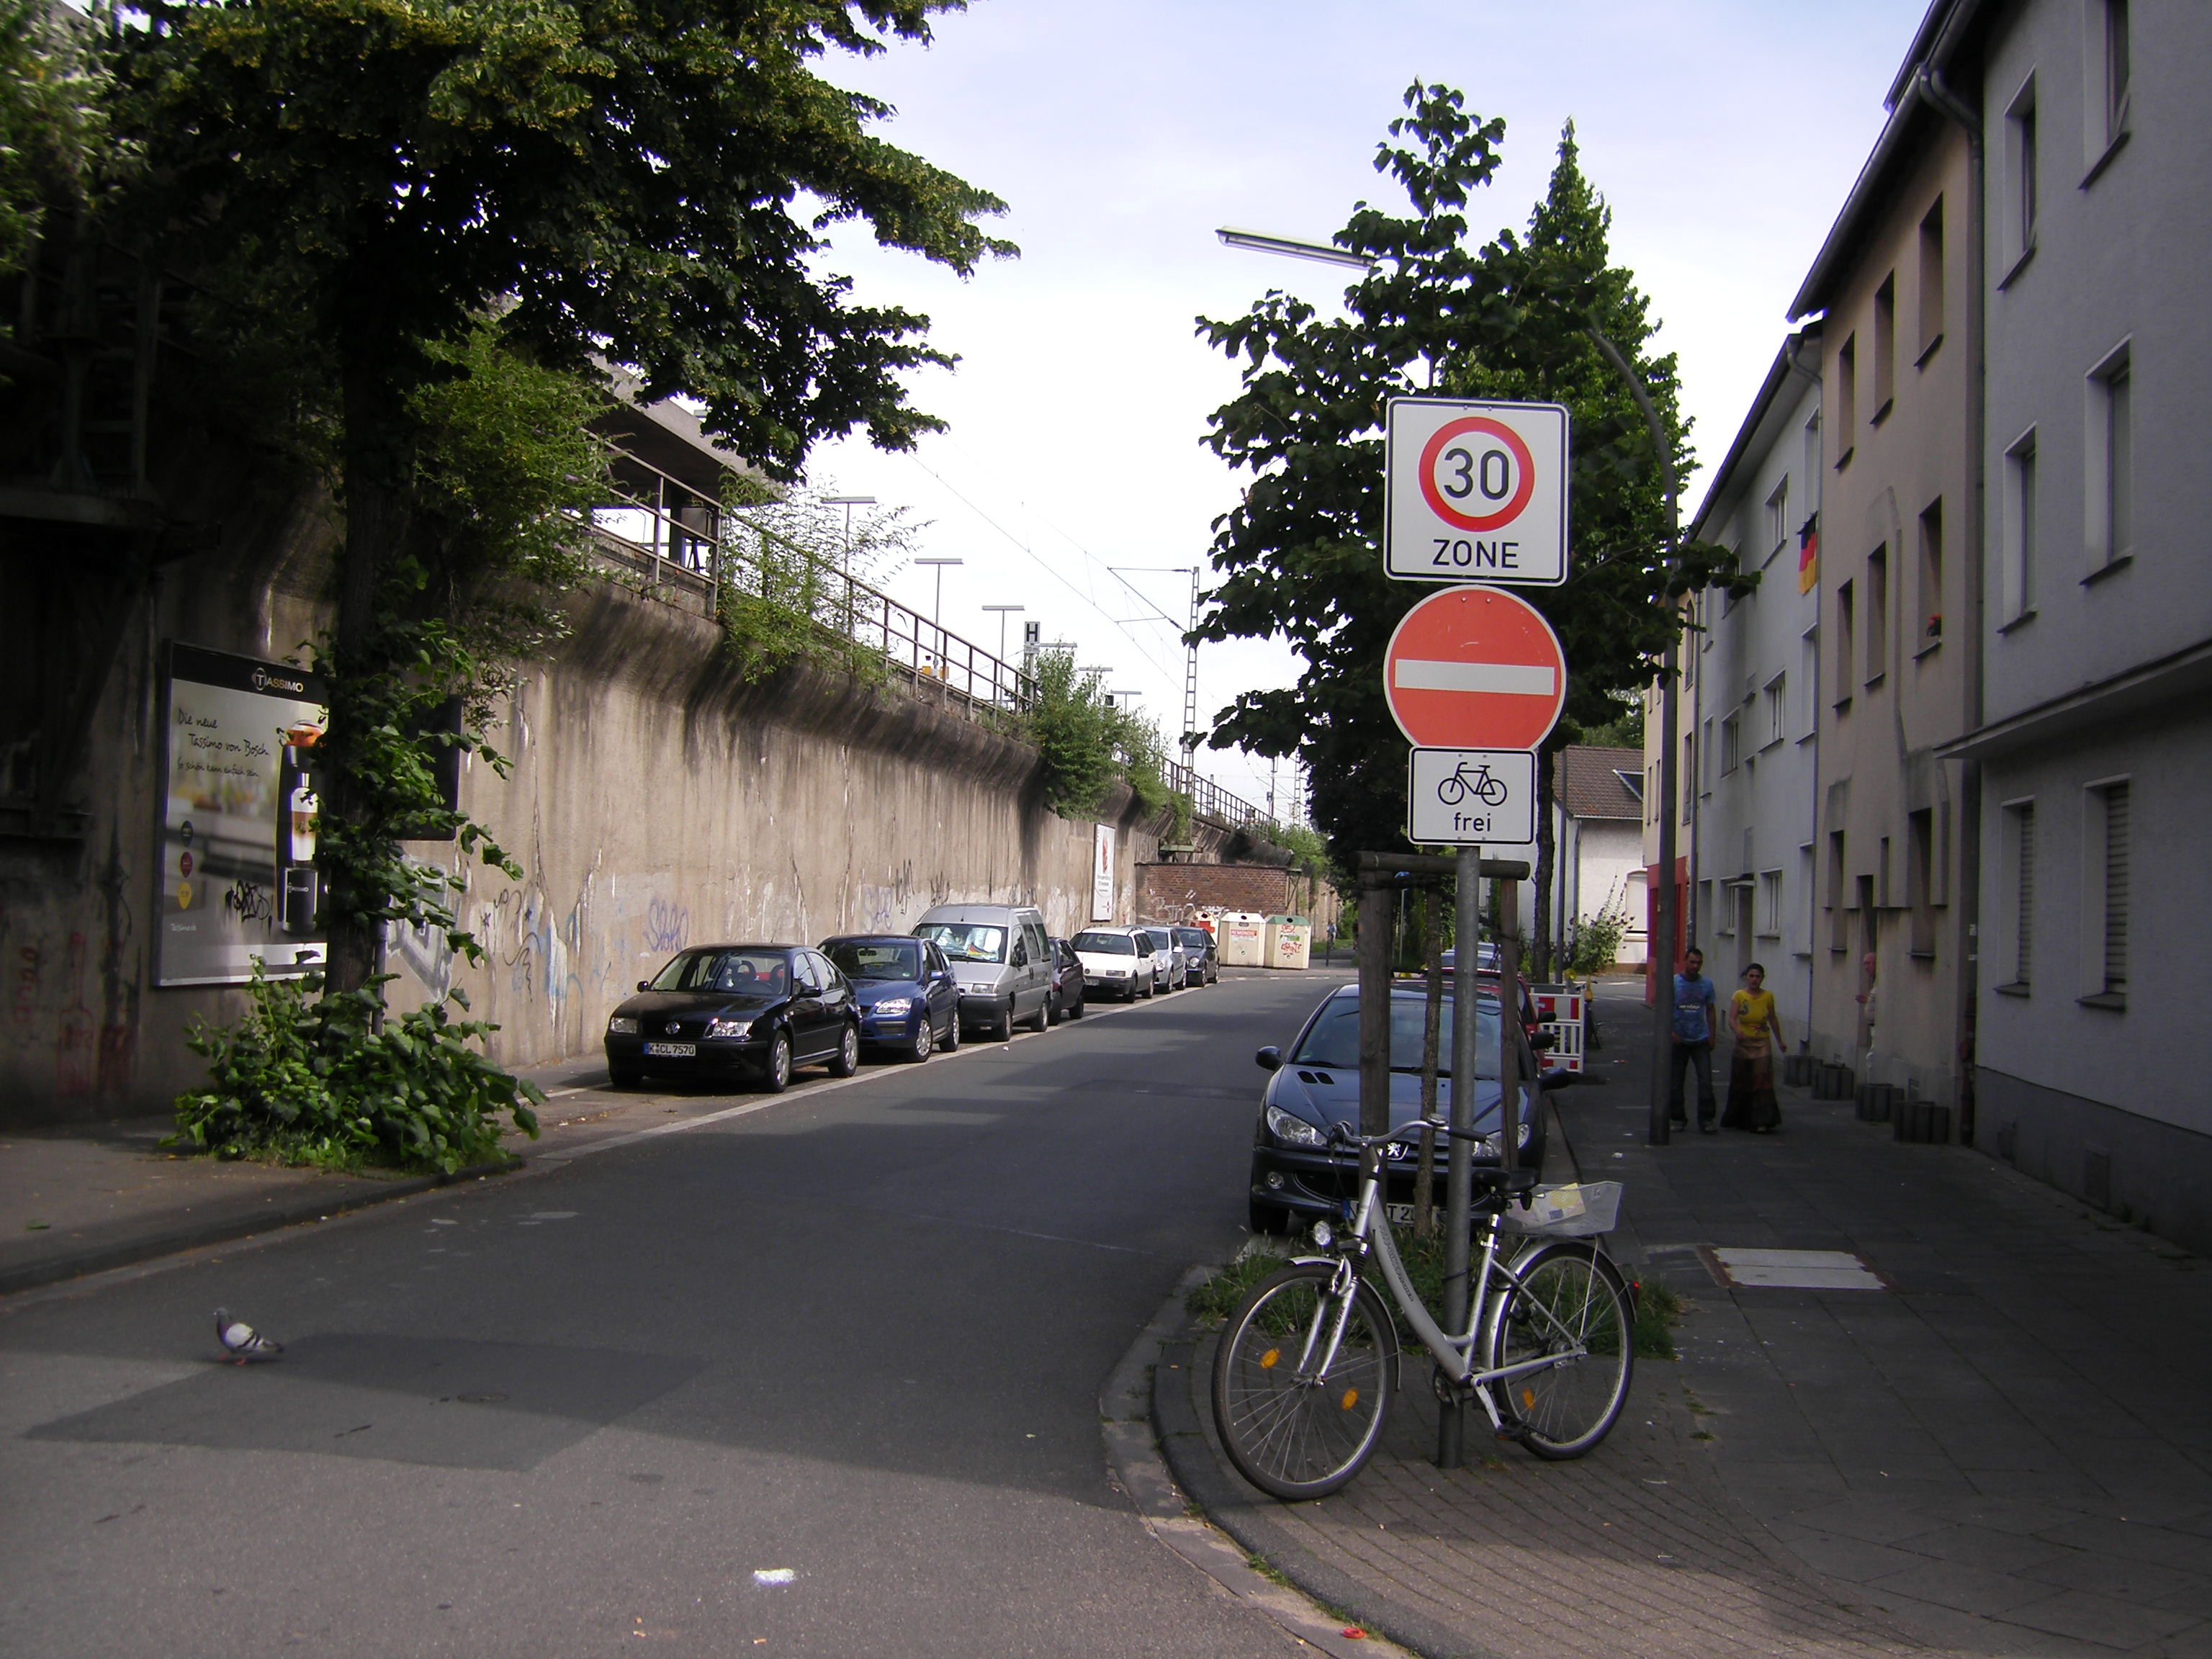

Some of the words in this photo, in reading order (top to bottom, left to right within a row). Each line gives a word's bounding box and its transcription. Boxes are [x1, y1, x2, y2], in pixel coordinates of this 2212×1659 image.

[1443, 447, 1510, 500] 30
[1432, 538, 1519, 569] ZONE
[1026, 623, 1038, 642] H
[253, 668, 304, 693] TASSIMO
[178, 708, 192, 725] Die
[196, 717, 217, 728] neue
[188, 732, 222, 750] Tassimo
[225, 742, 241, 752] von
[206, 763, 222, 773] kann
[1454, 812, 1491, 833] frei
[649, 1045, 655, 1053] K
[660, 1044, 671, 1054] CL
[673, 1045, 694, 1055] 7570
